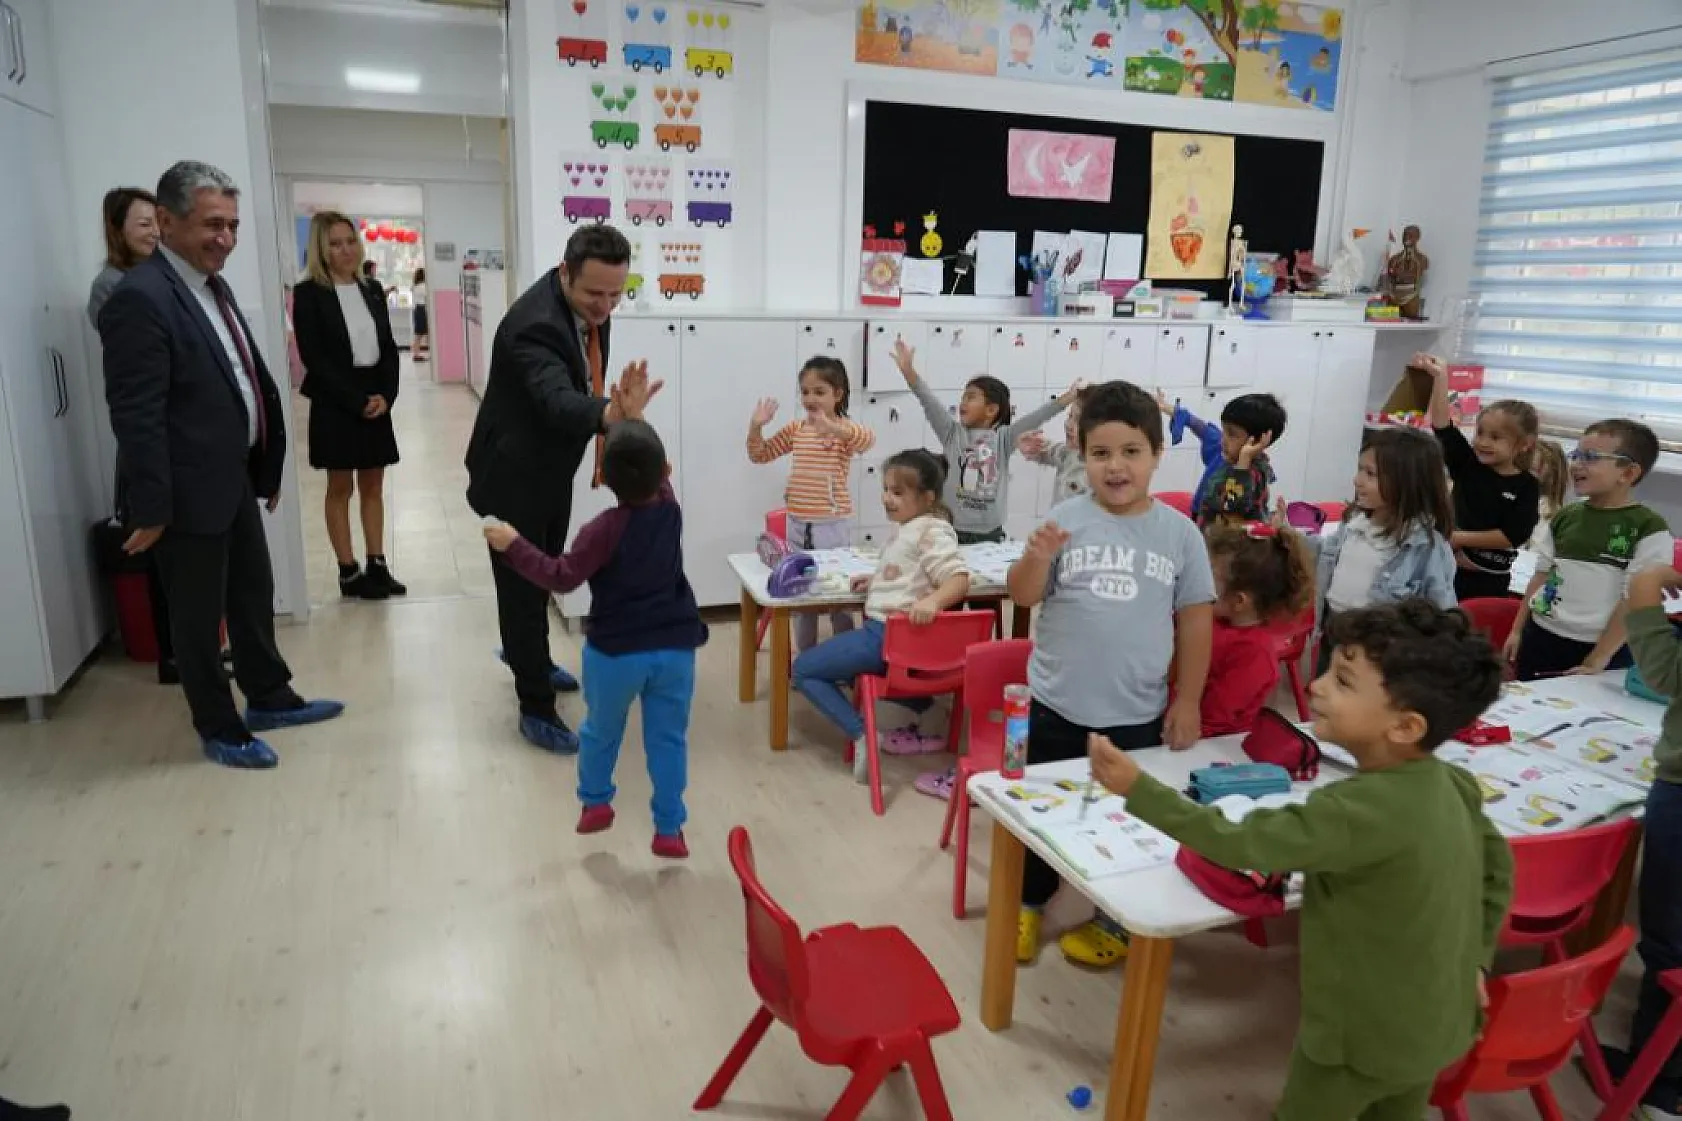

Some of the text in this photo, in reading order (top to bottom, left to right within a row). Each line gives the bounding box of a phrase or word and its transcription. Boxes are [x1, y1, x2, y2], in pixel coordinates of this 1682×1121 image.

[706, 54, 715, 68] 3
[611, 126, 622, 142] 4
[674, 128, 685, 143] 5
[646, 203, 657, 218] 7
[1144, 551, 1174, 586] BIG
